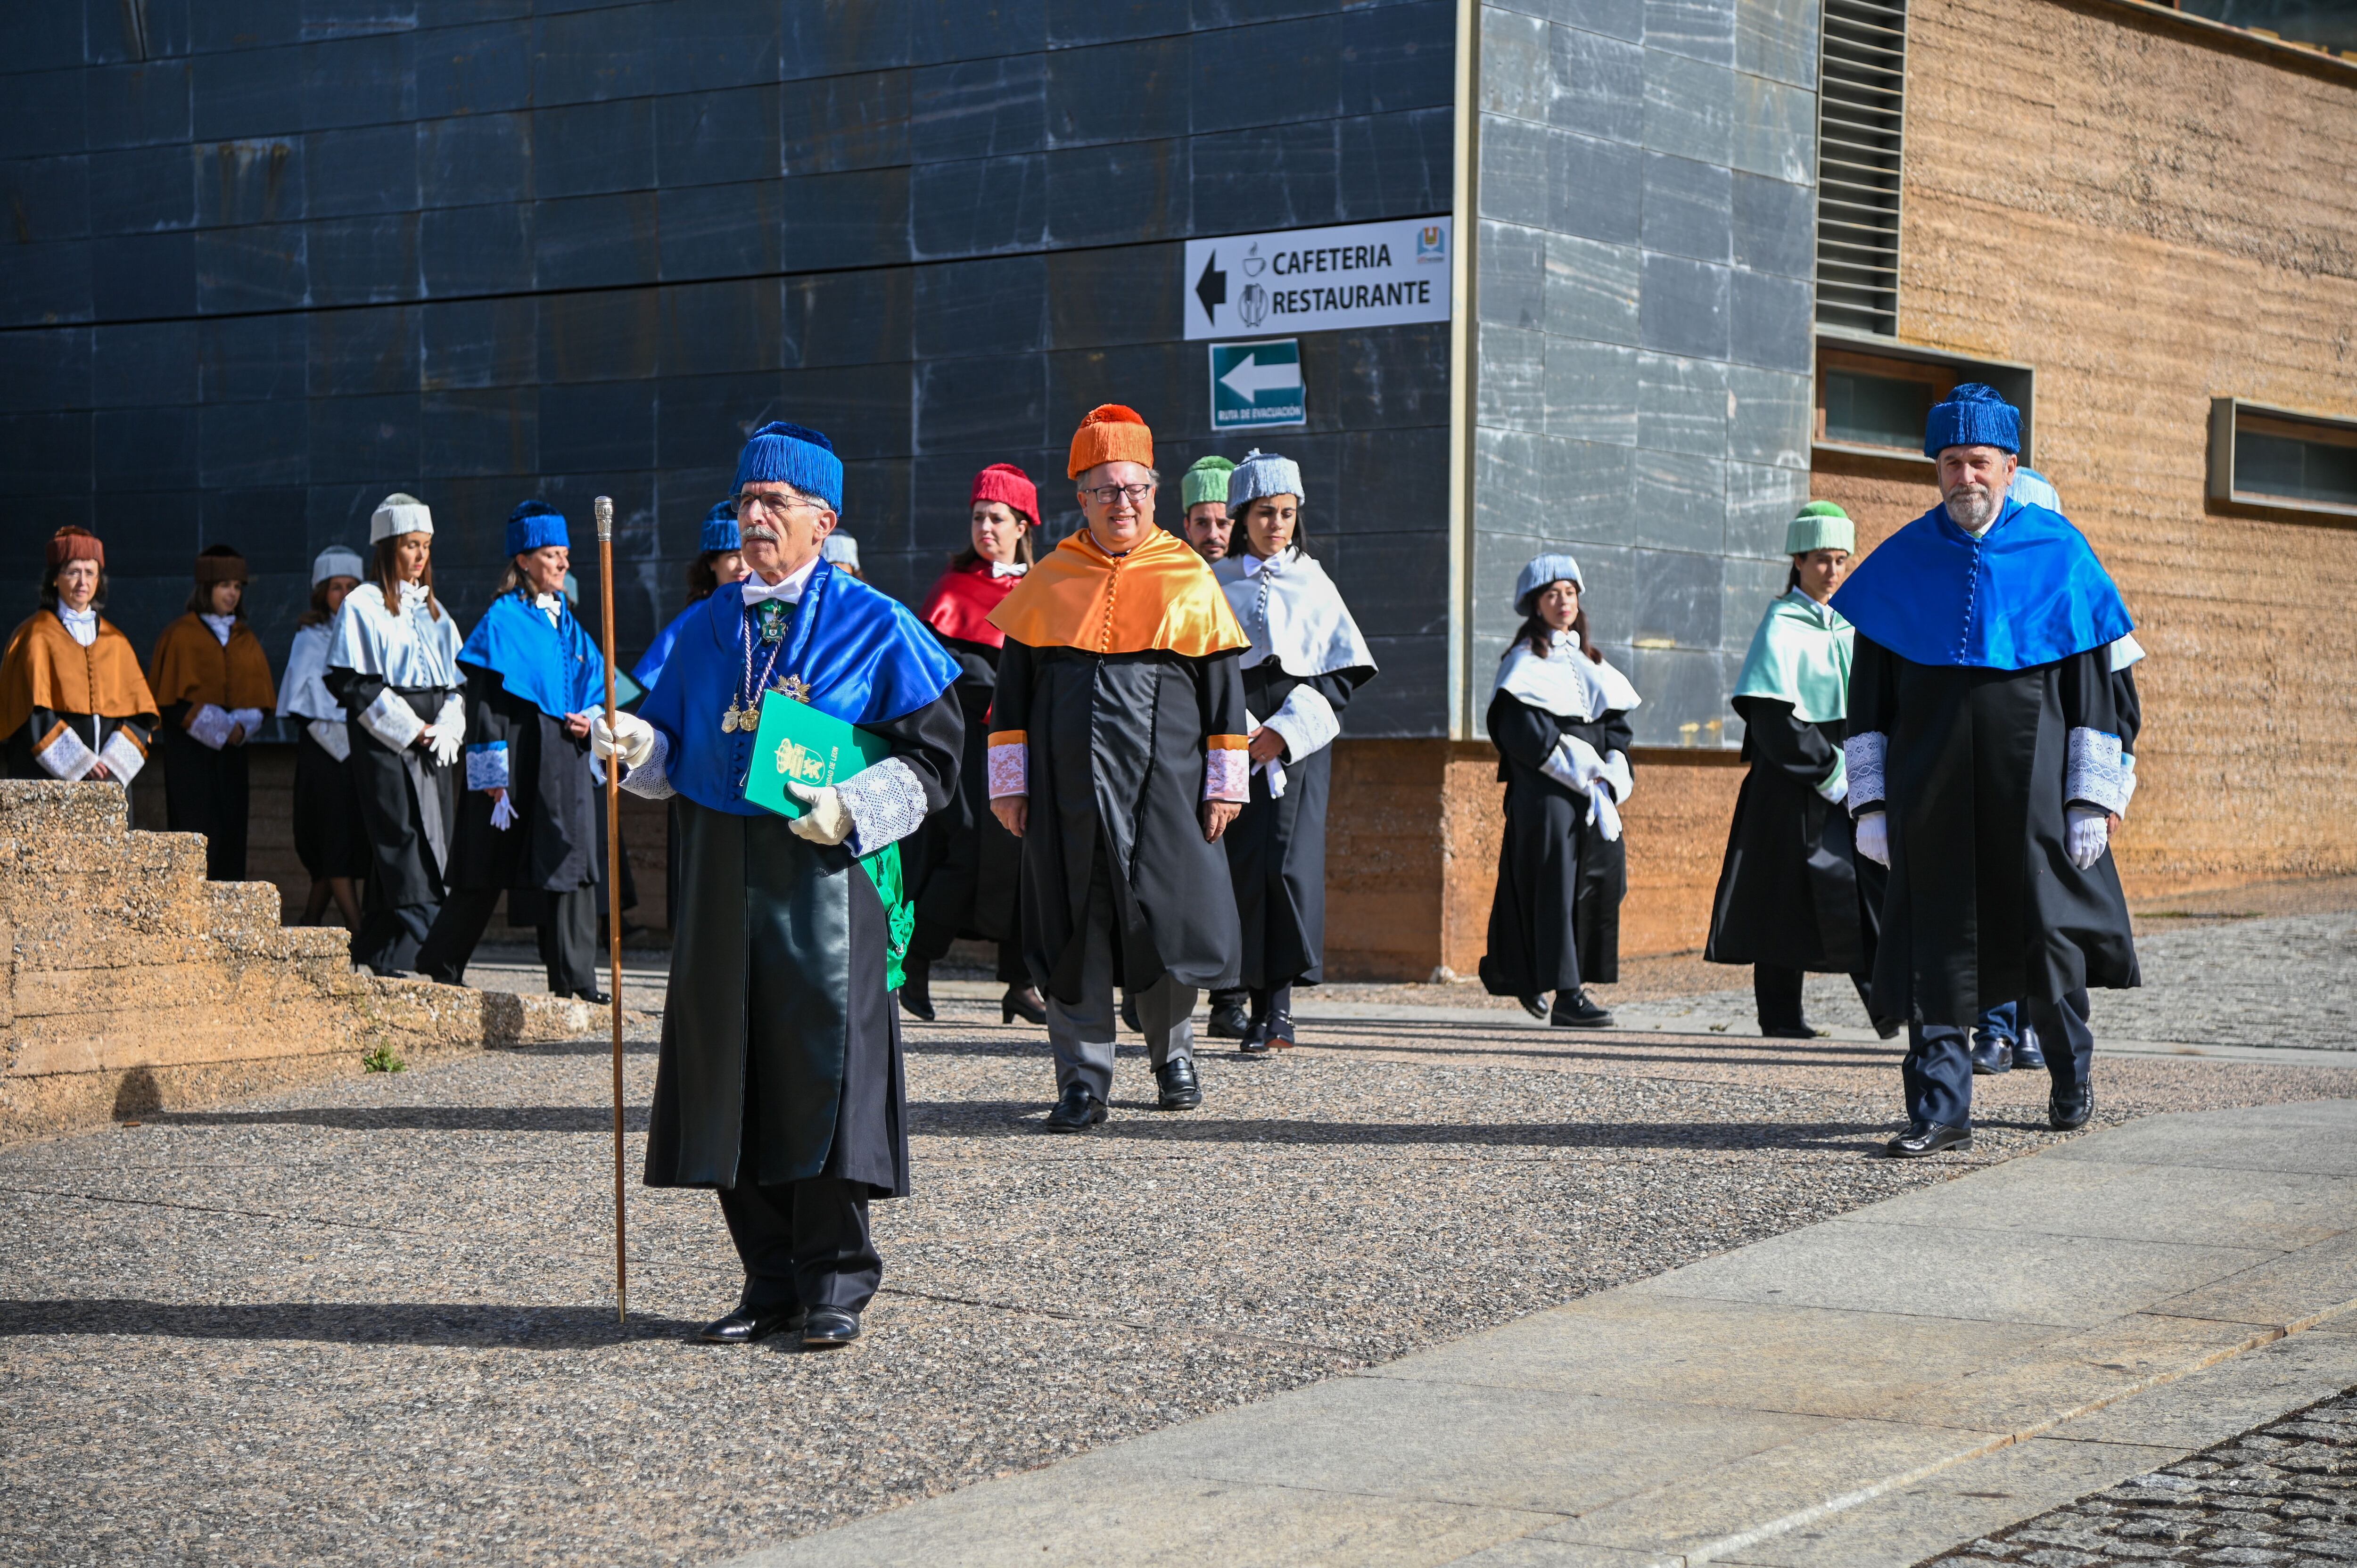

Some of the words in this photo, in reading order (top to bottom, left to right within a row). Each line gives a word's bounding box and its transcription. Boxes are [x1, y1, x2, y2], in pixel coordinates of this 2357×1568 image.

[1273, 244, 1391, 275] CAFETERIA
[1273, 280, 1430, 314] RESTAURANTE
[1218, 410, 1238, 420] RUTA
[1241, 409, 1250, 419] DE
[1253, 404, 1301, 419] EVACUACIÓN
[825, 770, 833, 787] SIDAD
[829, 761, 835, 770] DE
